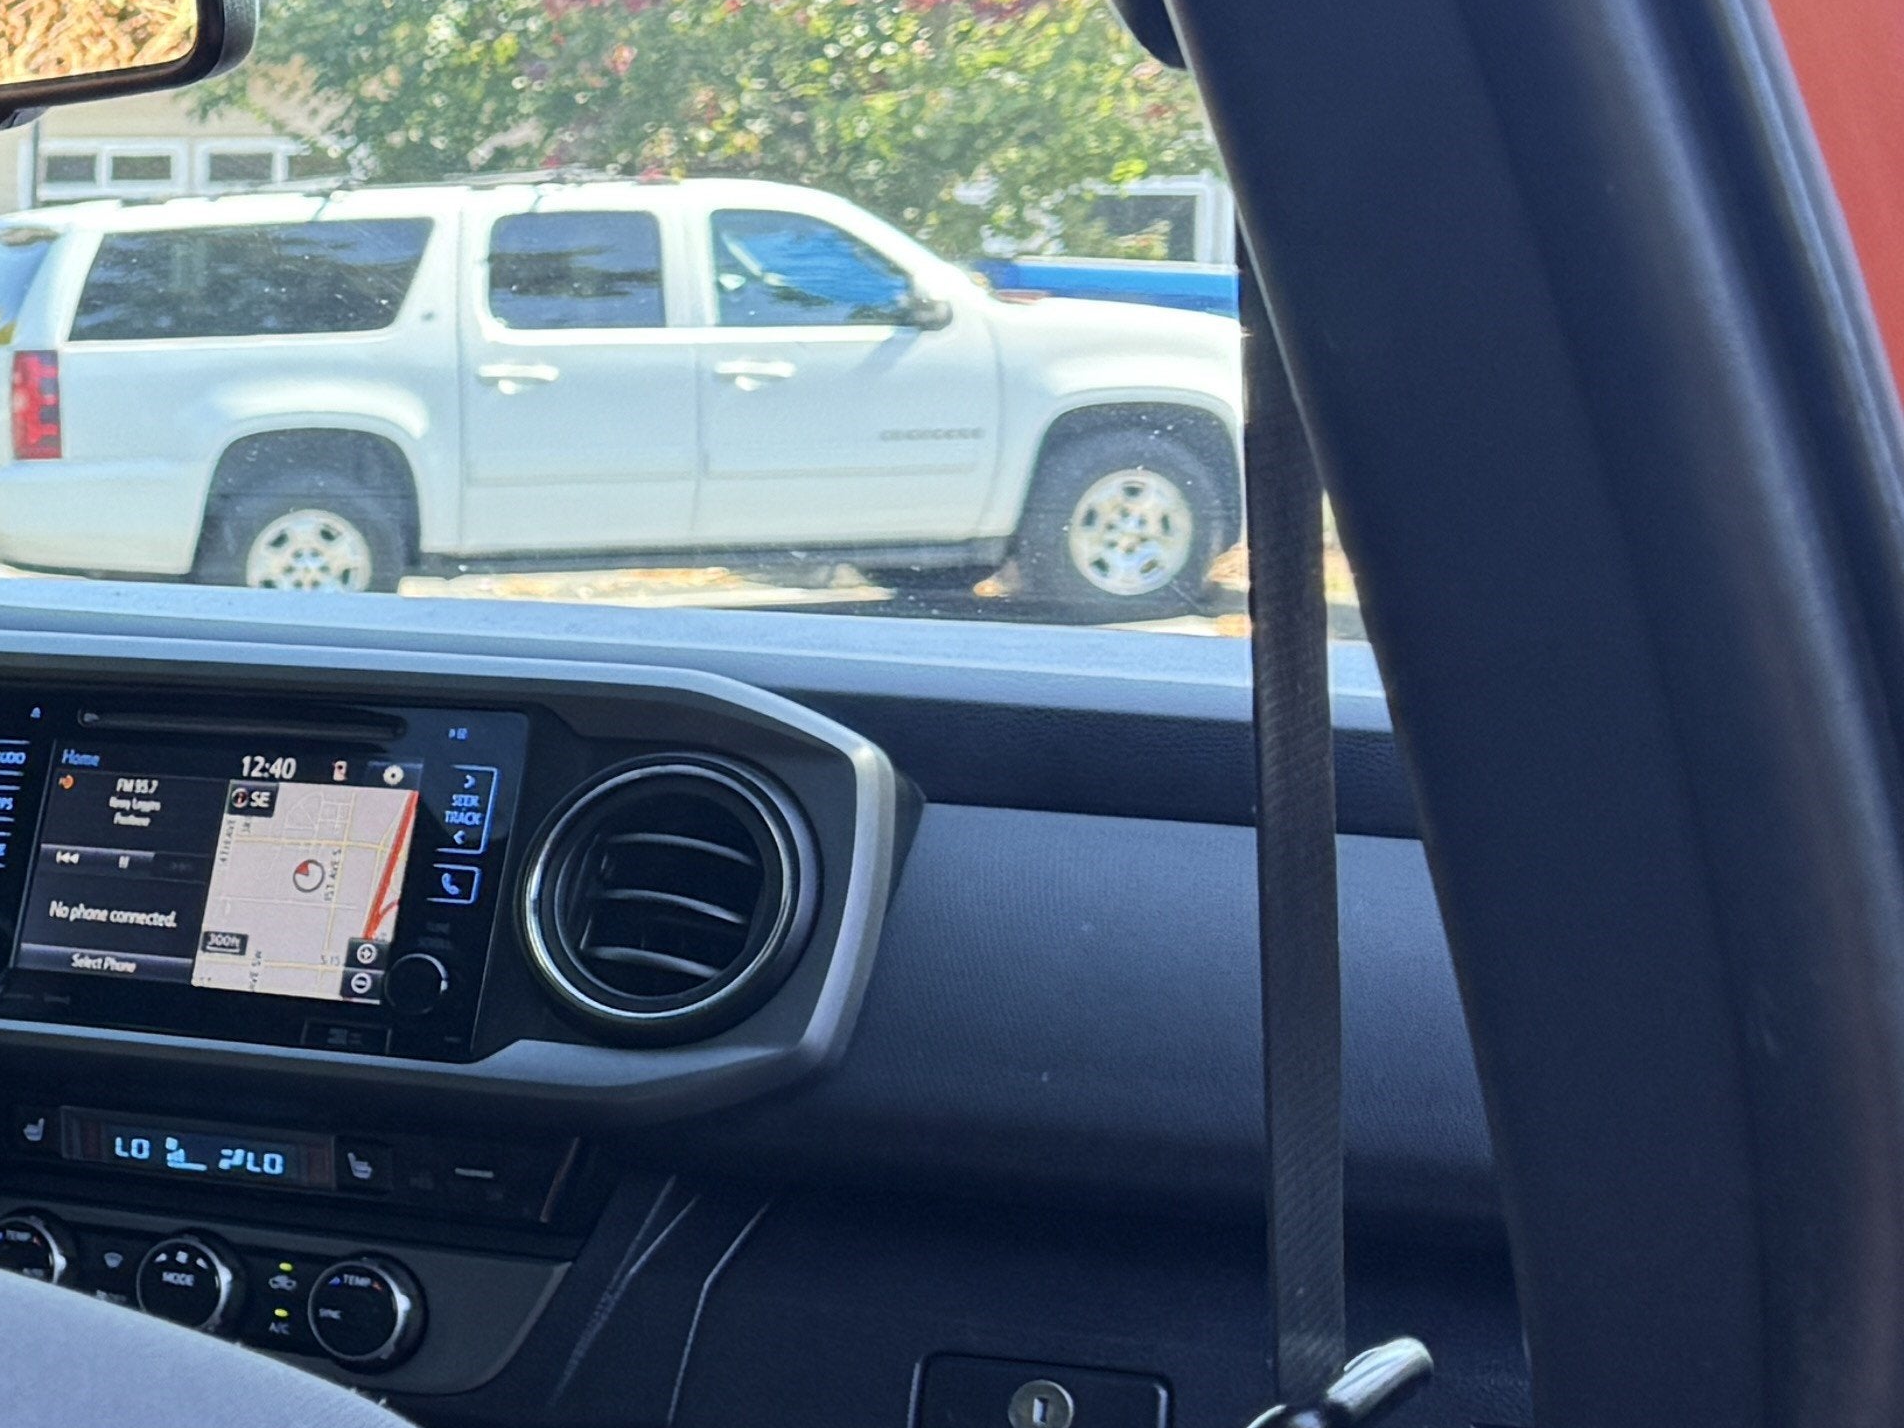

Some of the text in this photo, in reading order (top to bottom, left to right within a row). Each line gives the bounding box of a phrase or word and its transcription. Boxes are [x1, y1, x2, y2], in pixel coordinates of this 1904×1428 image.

[241, 755, 297, 780] 12:40
[249, 790, 271, 808] SE
[49, 900, 69, 919] No
[69, 903, 108, 923] phone
[71, 952, 137, 974] Select Phone
